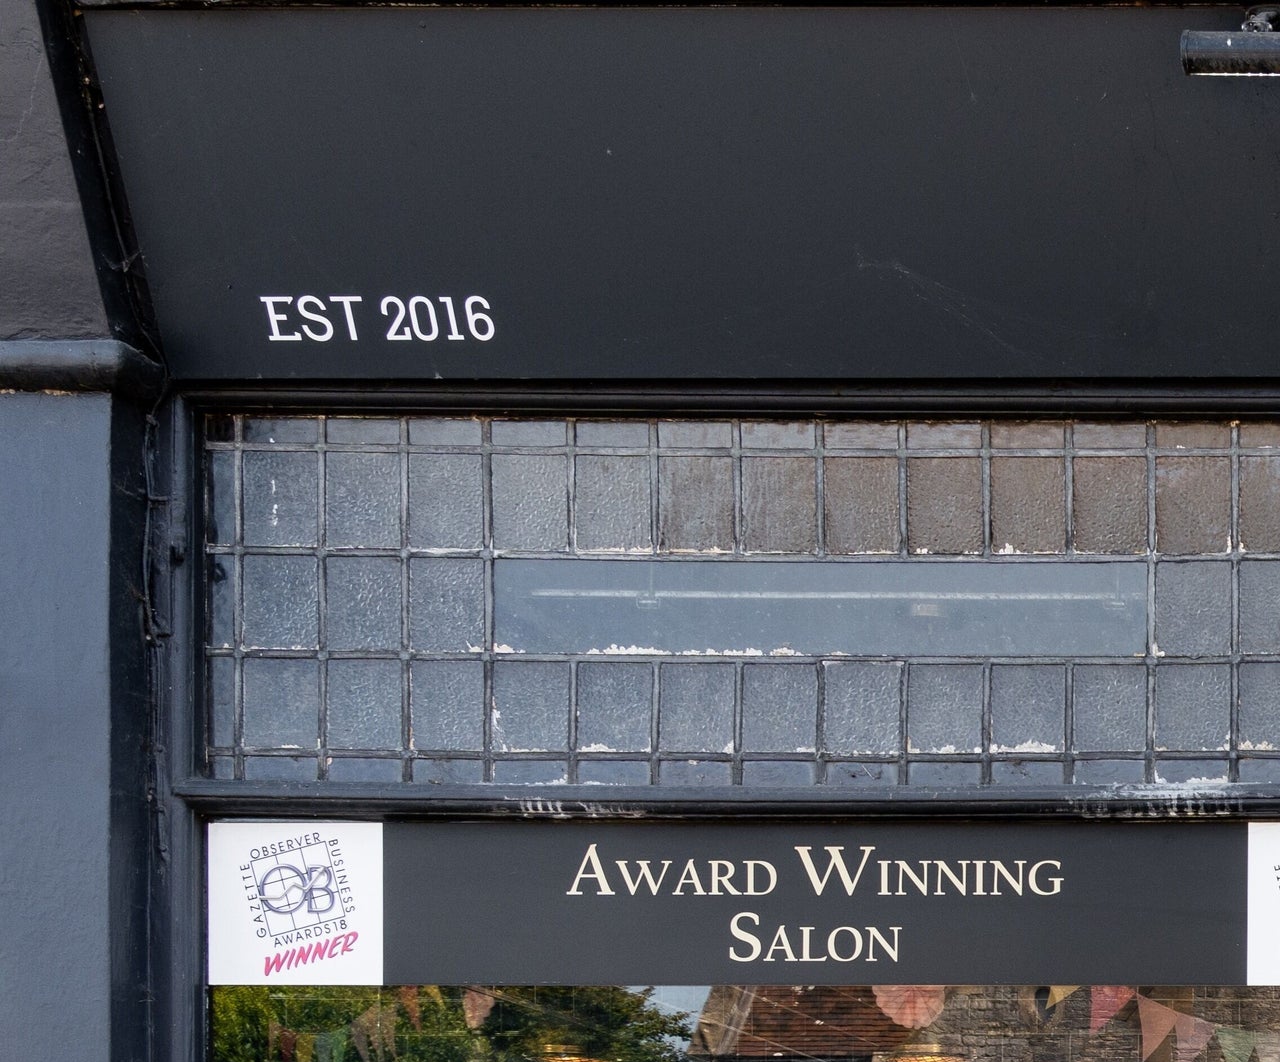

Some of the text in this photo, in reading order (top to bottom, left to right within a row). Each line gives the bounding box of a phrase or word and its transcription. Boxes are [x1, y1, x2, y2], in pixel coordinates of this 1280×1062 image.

[259, 294, 496, 342] EST 2016
[250, 832, 321, 860] OBSERVER
[328, 838, 356, 913] BUSINESS
[240, 863, 267, 938] GAZETTE
[264, 931, 359, 977] WINNER
